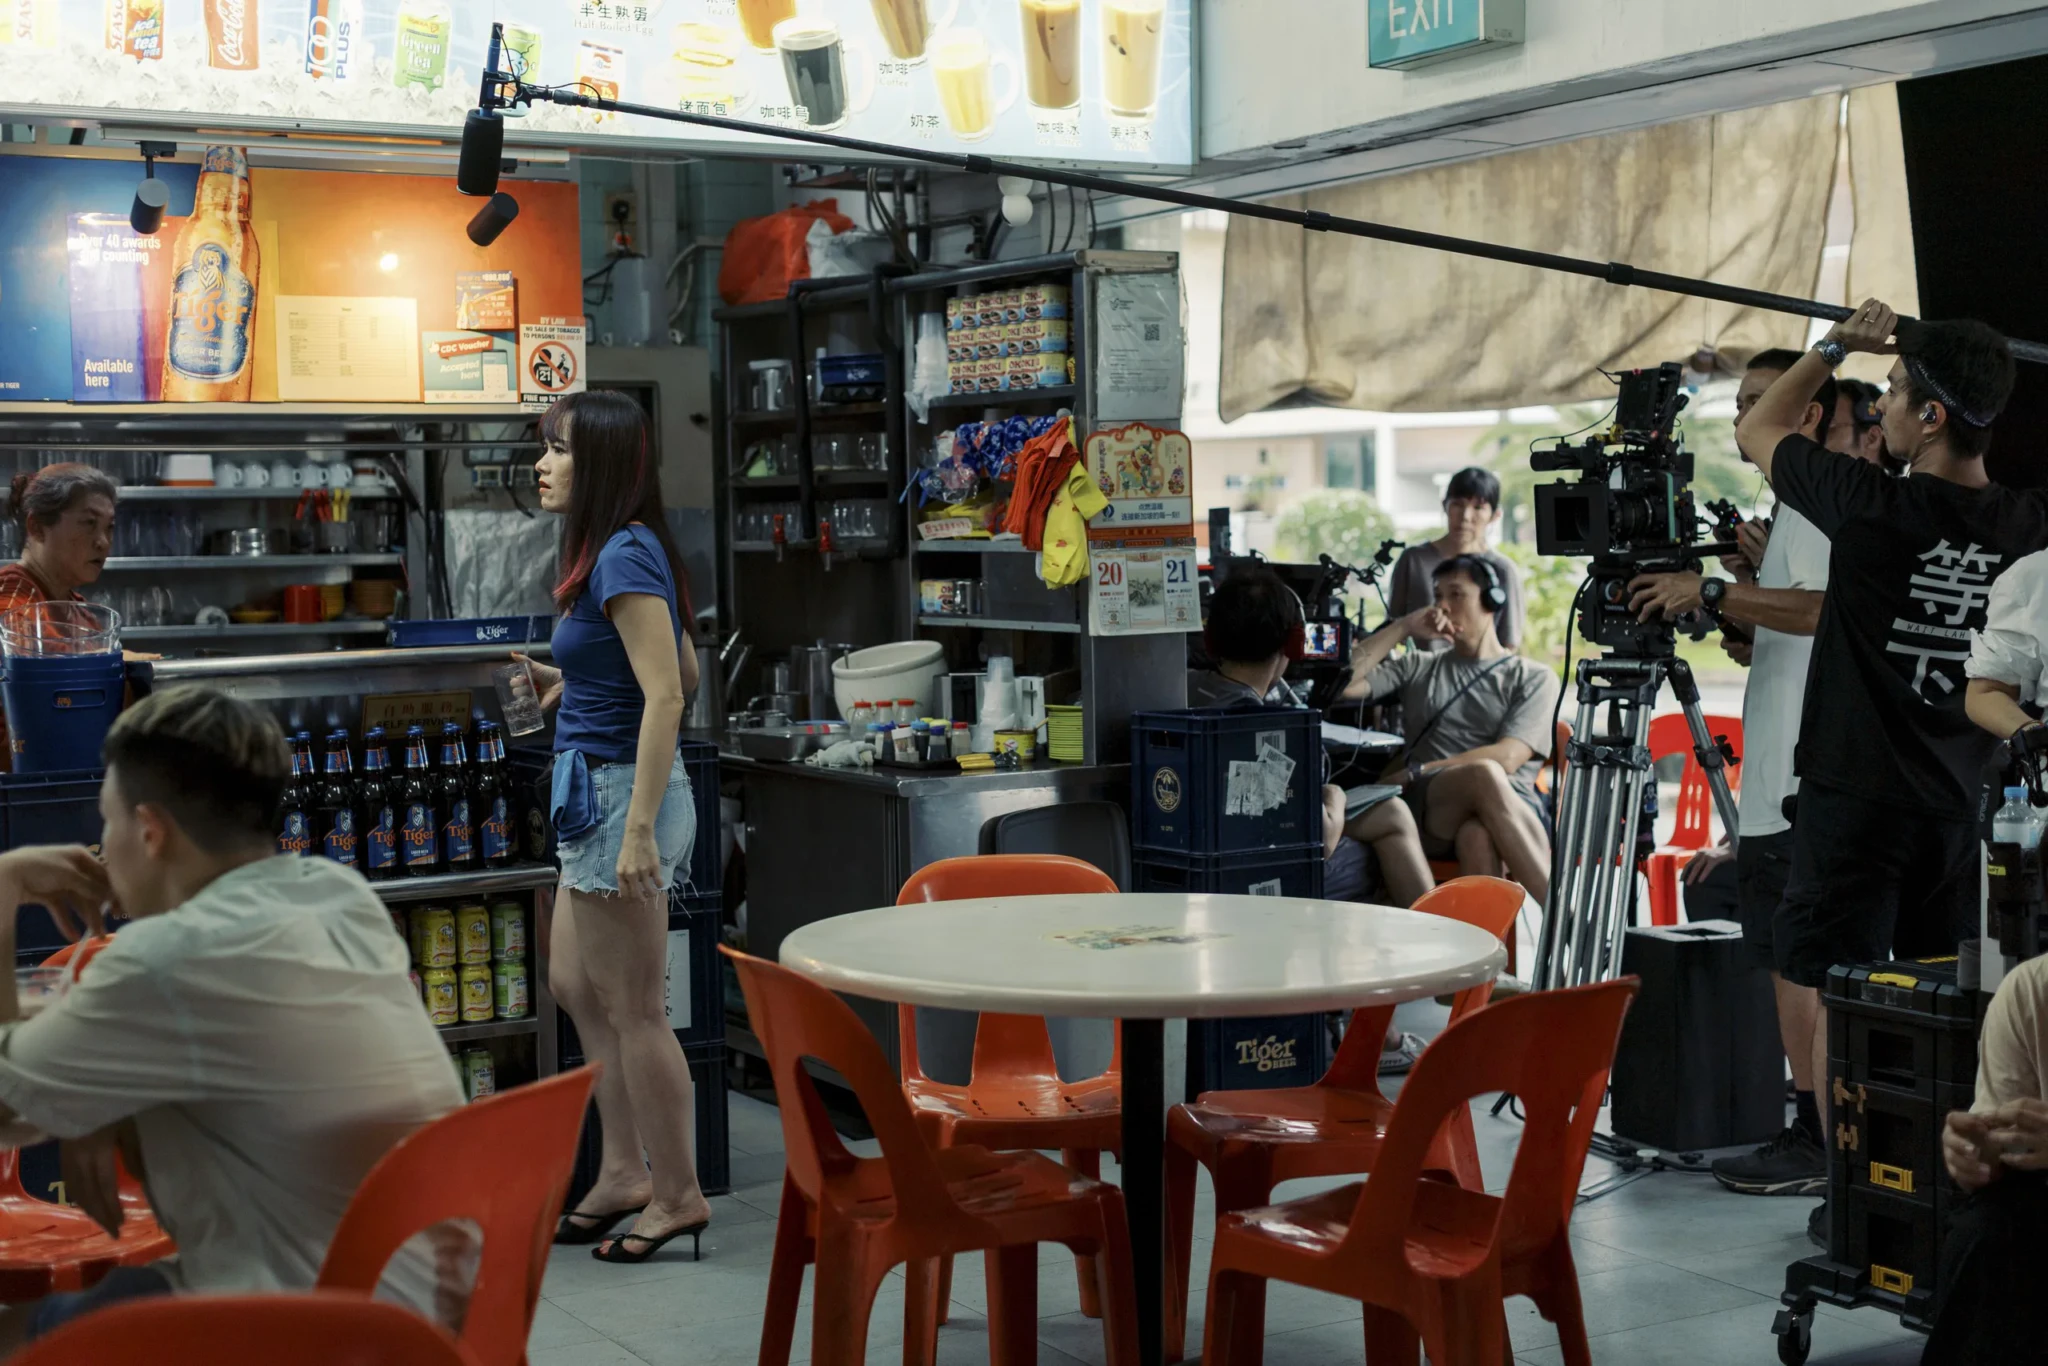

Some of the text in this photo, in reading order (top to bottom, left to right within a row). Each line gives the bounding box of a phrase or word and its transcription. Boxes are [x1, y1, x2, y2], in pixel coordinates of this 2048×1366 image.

[580, 6, 648, 22] 半生熟蛋
[306, 15, 336, 74] 100
[336, 22, 350, 79] PLUS
[401, 33, 441, 55] Green
[408, 50, 432, 68] Tea
[910, 114, 940, 128] 奶茶
[107, 235, 119, 247] 40
[122, 235, 161, 249] awards
[103, 250, 149, 265] counting
[174, 288, 248, 333] Tiger
[540, 317, 566, 325] BY LAW
[440, 340, 489, 354] CDC Voucher
[84, 359, 133, 373] Available
[85, 374, 109, 387] here
[539, 371, 551, 382] 21
[1098, 562, 1122, 585] 20
[1166, 560, 1190, 583] 21
[485, 624, 509, 638] Tiger
[1906, 623, 1966, 639] WAIT LAH
[376, 716, 456, 729] SELF SERVICE
[375, 830, 396, 847] Tig
[403, 828, 435, 846] Tiger
[449, 824, 475, 841] Tige
[280, 834, 311, 852] Tiger
[330, 833, 358, 851] Tige
[1236, 1035, 1295, 1072] Tiger
[1272, 1058, 1296, 1069] BEER
